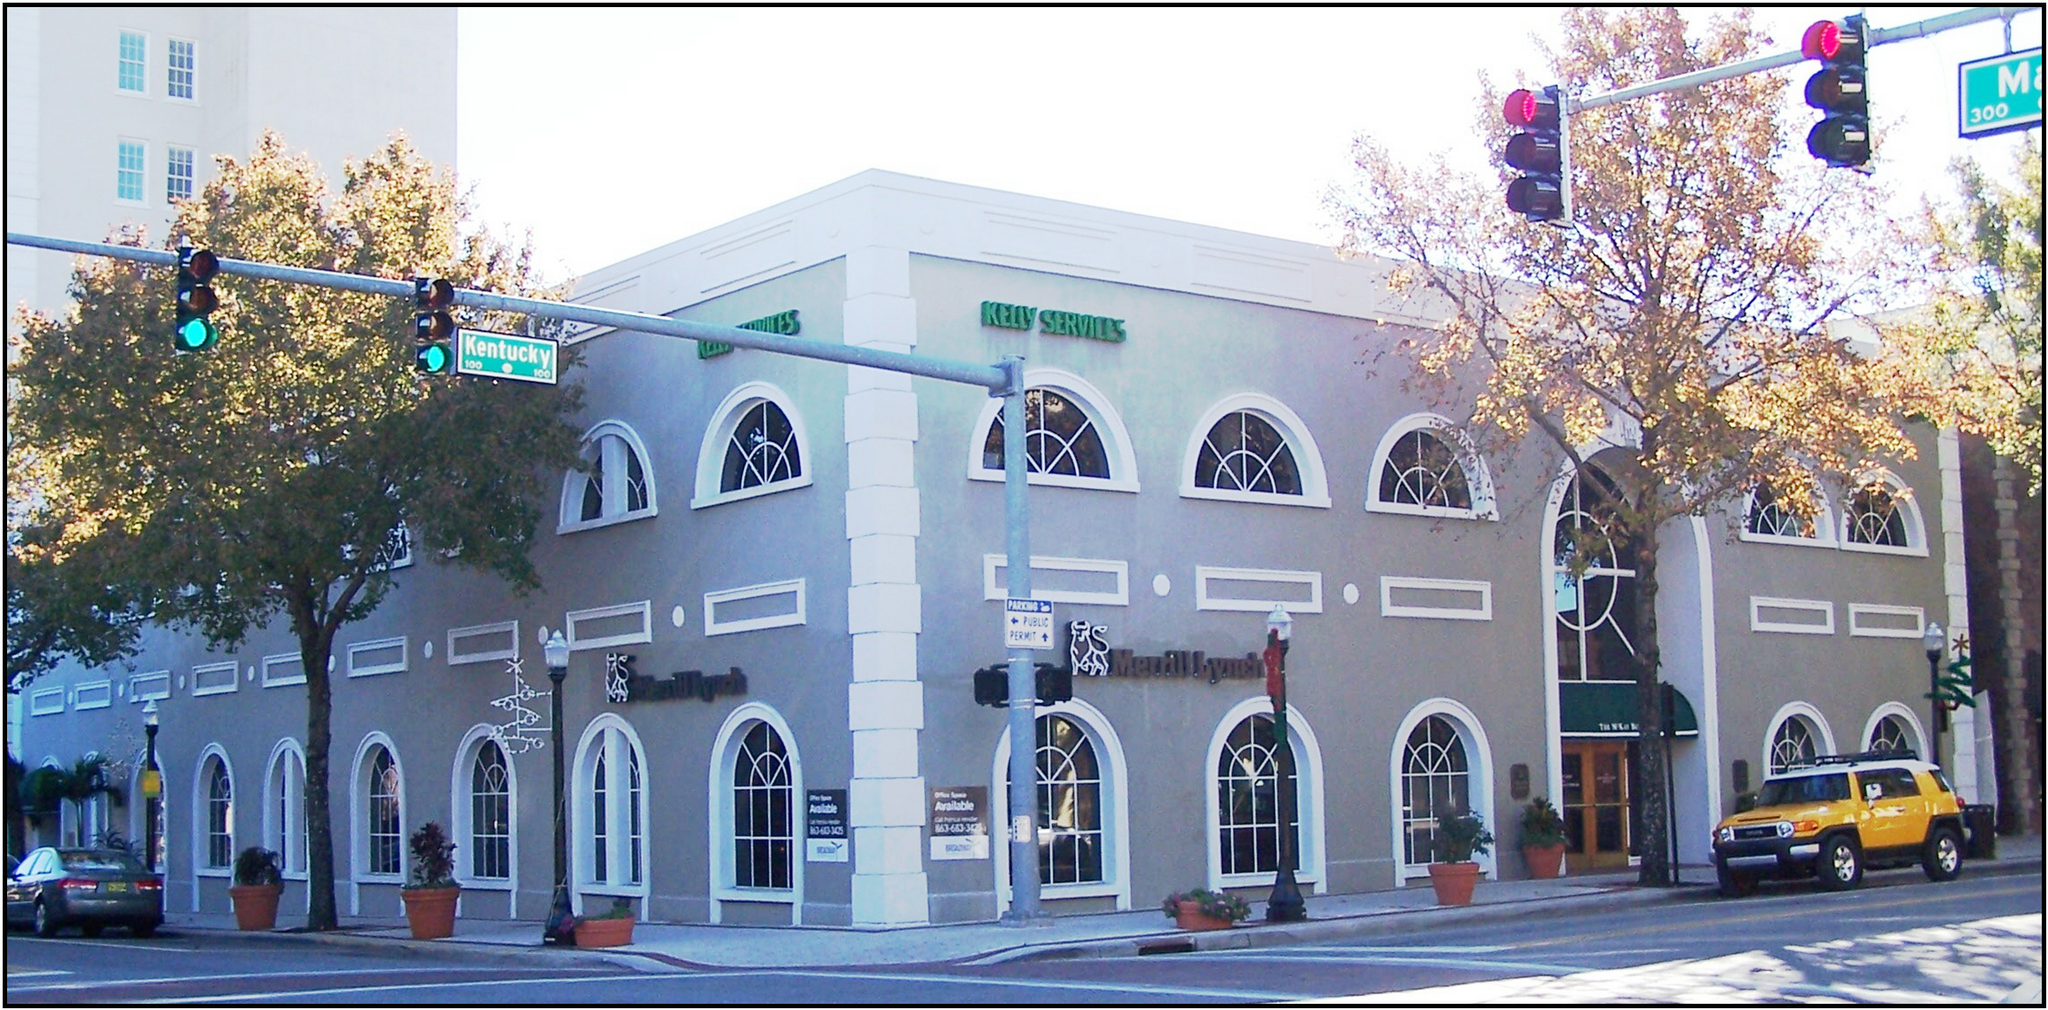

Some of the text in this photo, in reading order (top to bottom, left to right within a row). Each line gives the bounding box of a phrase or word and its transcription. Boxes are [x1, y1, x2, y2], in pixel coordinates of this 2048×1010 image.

[1970, 102, 2009, 123] 300
[981, 301, 1127, 343] KELLY SERVICES
[465, 335, 551, 370] Kentucky
[465, 360, 551, 378] 100 100
[1023, 616, 1049, 628] PUBLIC
[1010, 630, 1037, 641] PERMIT
[1110, 649, 1268, 684] Merrill Lynch
[809, 803, 838, 814] Available
[935, 800, 975, 811] Available
